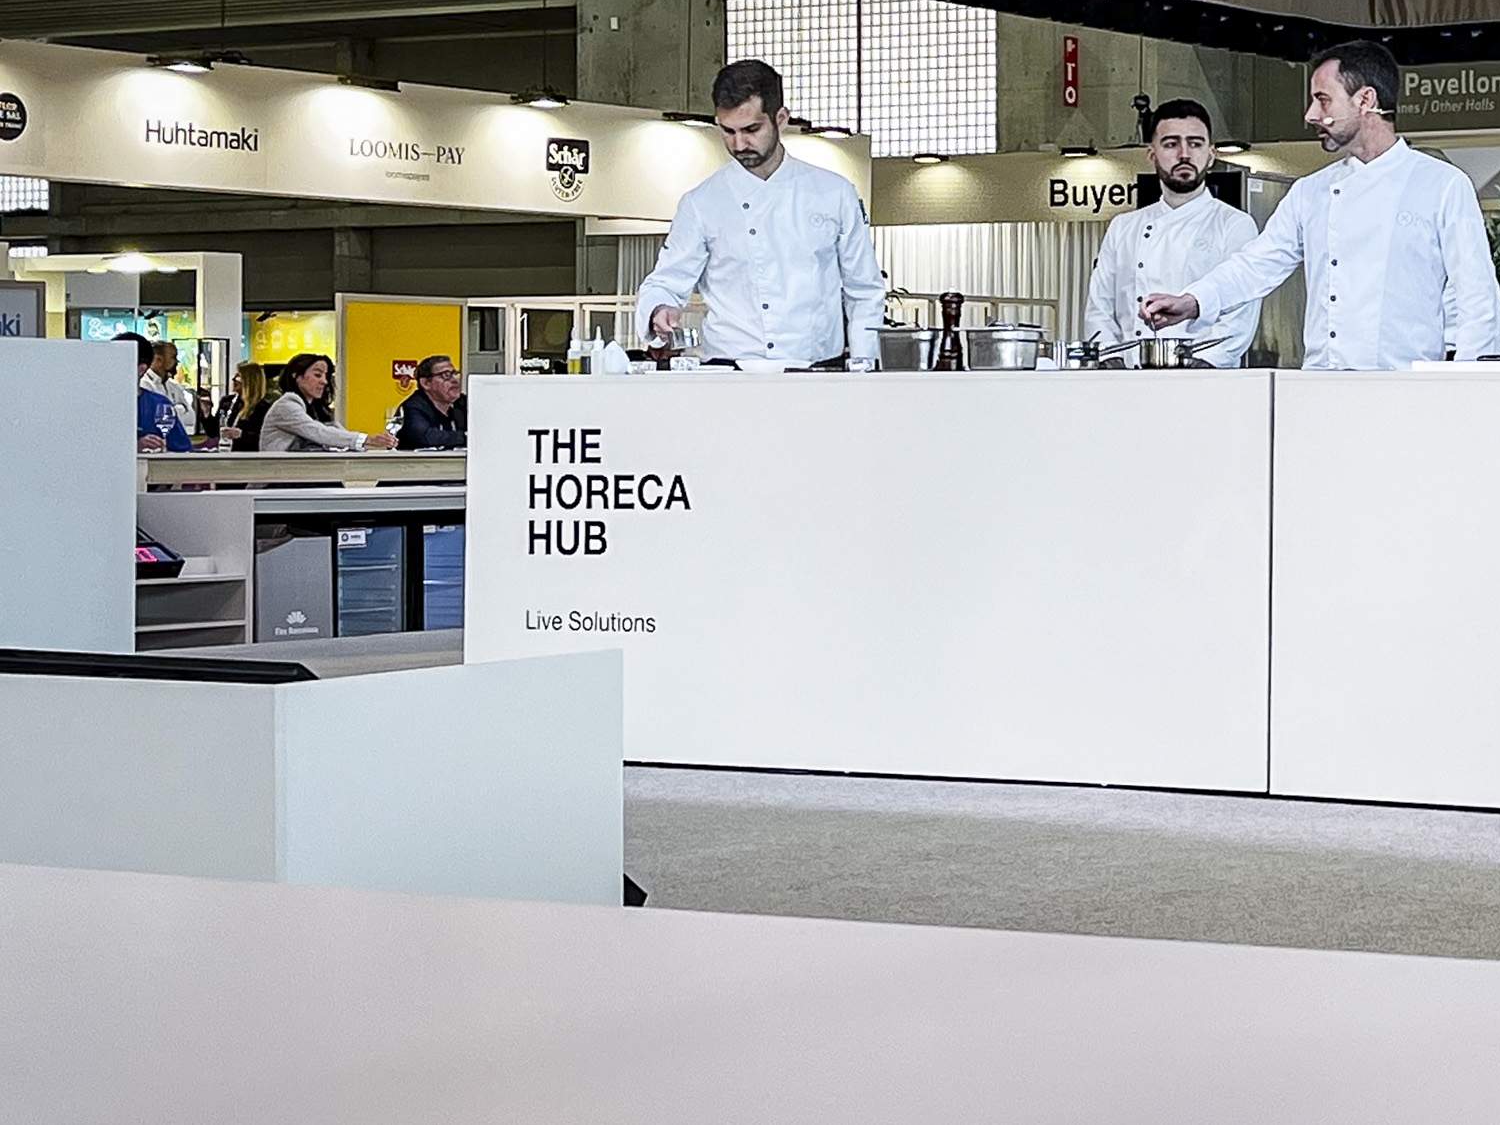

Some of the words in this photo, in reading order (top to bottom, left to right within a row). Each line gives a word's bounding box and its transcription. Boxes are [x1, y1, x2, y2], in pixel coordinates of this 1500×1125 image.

[1430, 99, 1464, 113] Other
[145, 120, 259, 152] Huhtamaki
[527, 428, 602, 464] THE
[528, 474, 692, 510] HORECA
[528, 520, 607, 556] HUB
[525, 609, 563, 631] Live
[568, 610, 656, 633] Solutions
